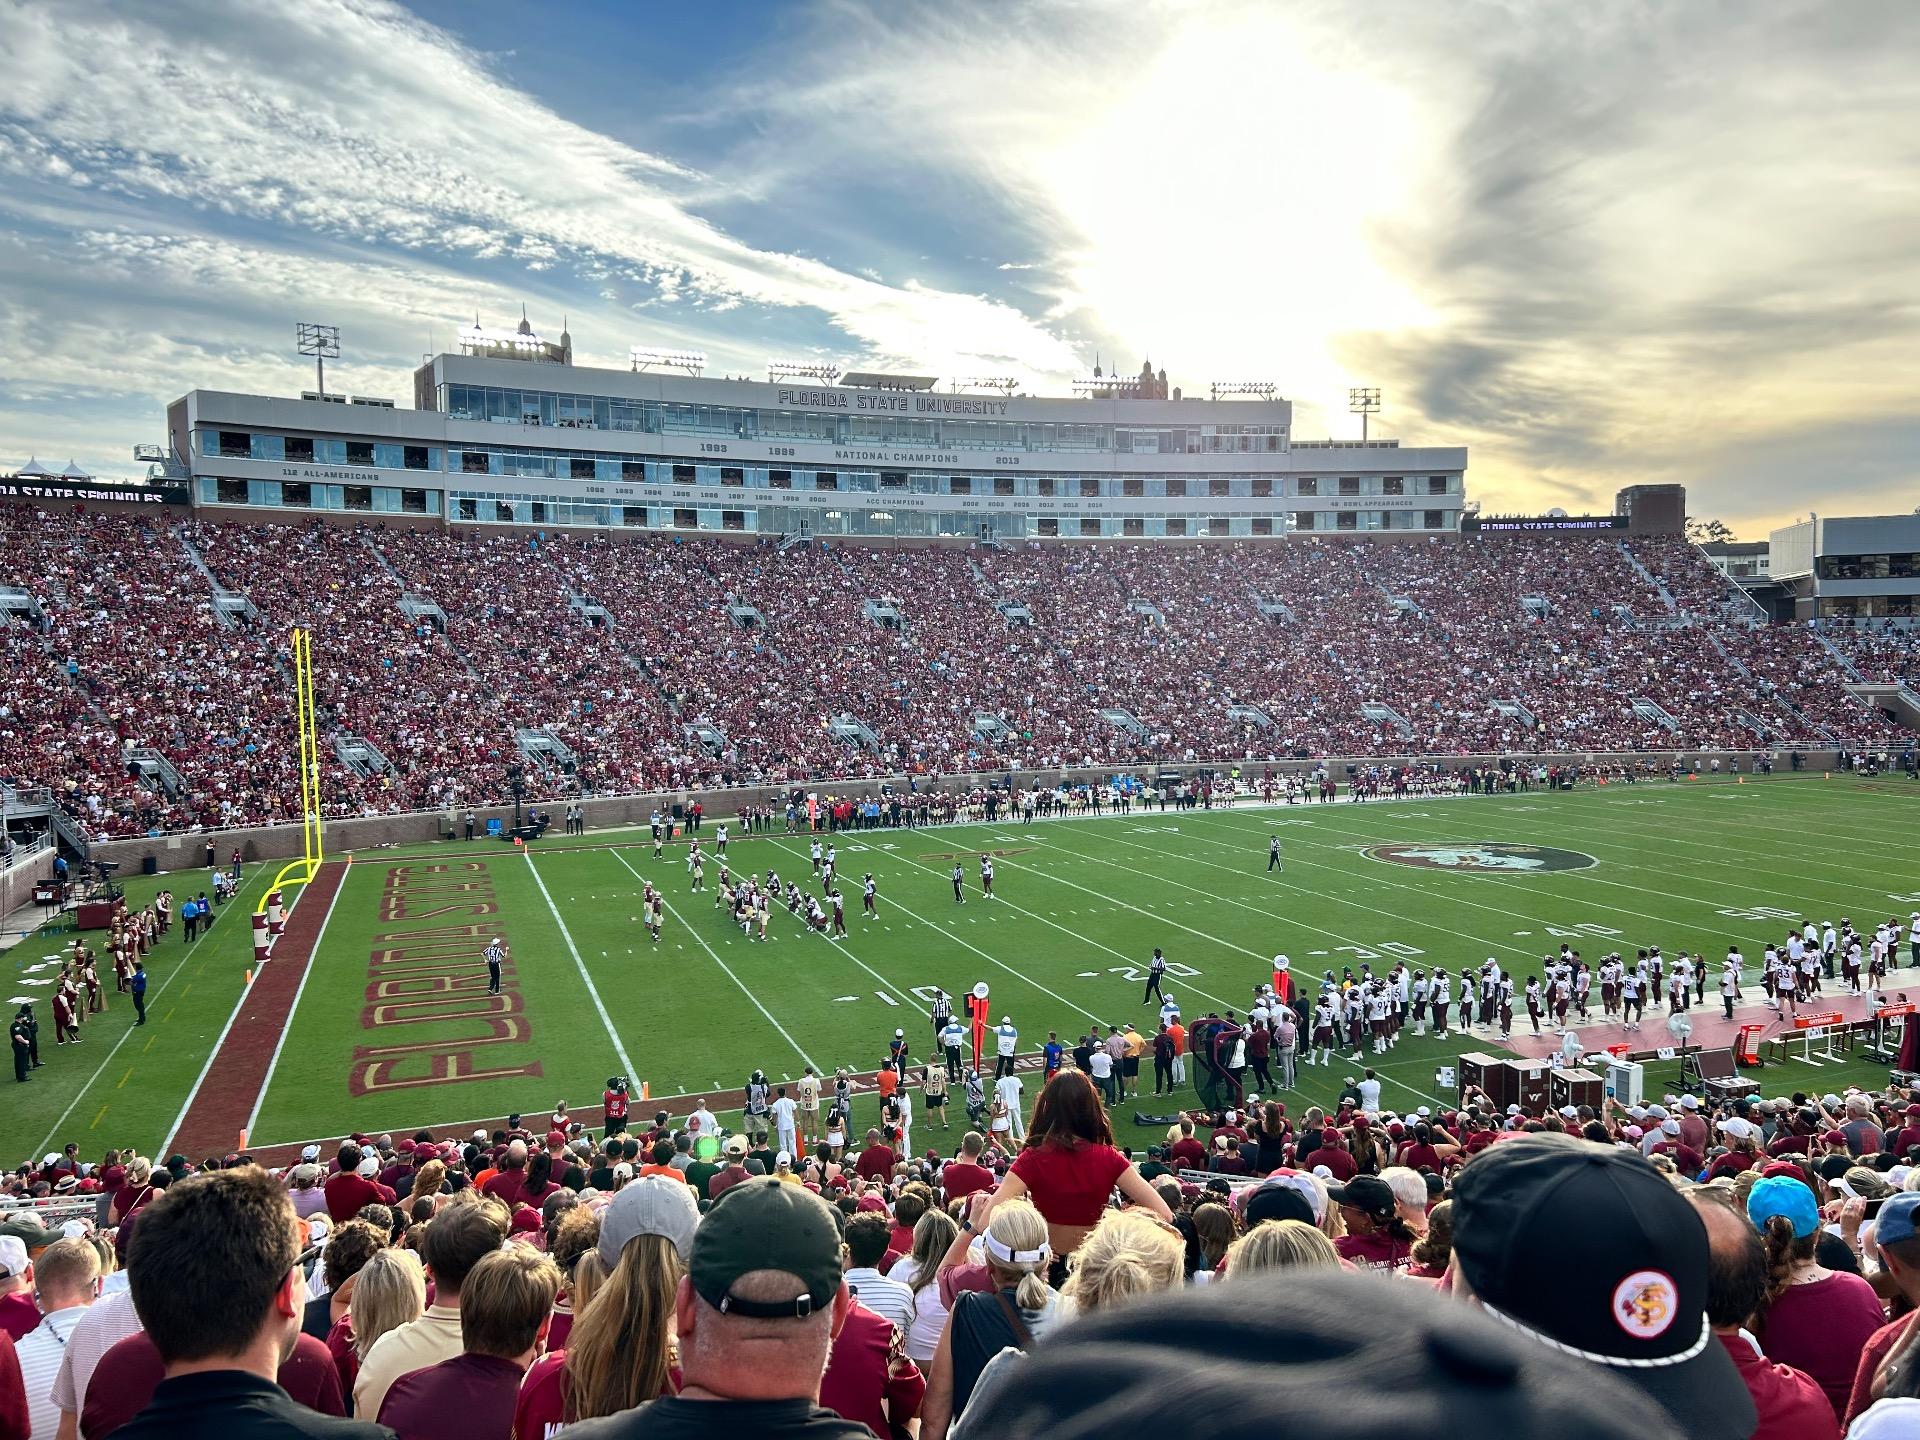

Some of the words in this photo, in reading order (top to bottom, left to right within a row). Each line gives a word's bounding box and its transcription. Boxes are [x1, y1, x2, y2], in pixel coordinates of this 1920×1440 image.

[778, 389, 848, 408] FLORIDA
[857, 394, 908, 410] STATE
[916, 398, 1008, 415] UNIVERSITY
[700, 443, 727, 453] 1993
[835, 450, 889, 461] NATIONAL
[894, 453, 958, 463] CHAMPIONS
[996, 456, 1020, 465] 2013
[282, 468, 298, 476] 112
[304, 470, 379, 481] ALL-AMERICANS
[22, 486, 73, 498] STATE
[379, 862, 498, 922] STATE
[1715, 906, 1802, 920] 50
[1544, 922, 1625, 939] 40
[1333, 942, 1427, 959] 30
[1107, 962, 1204, 982] 20
[873, 985, 953, 1006] 10
[349, 921, 544, 1097] FLORIDA
